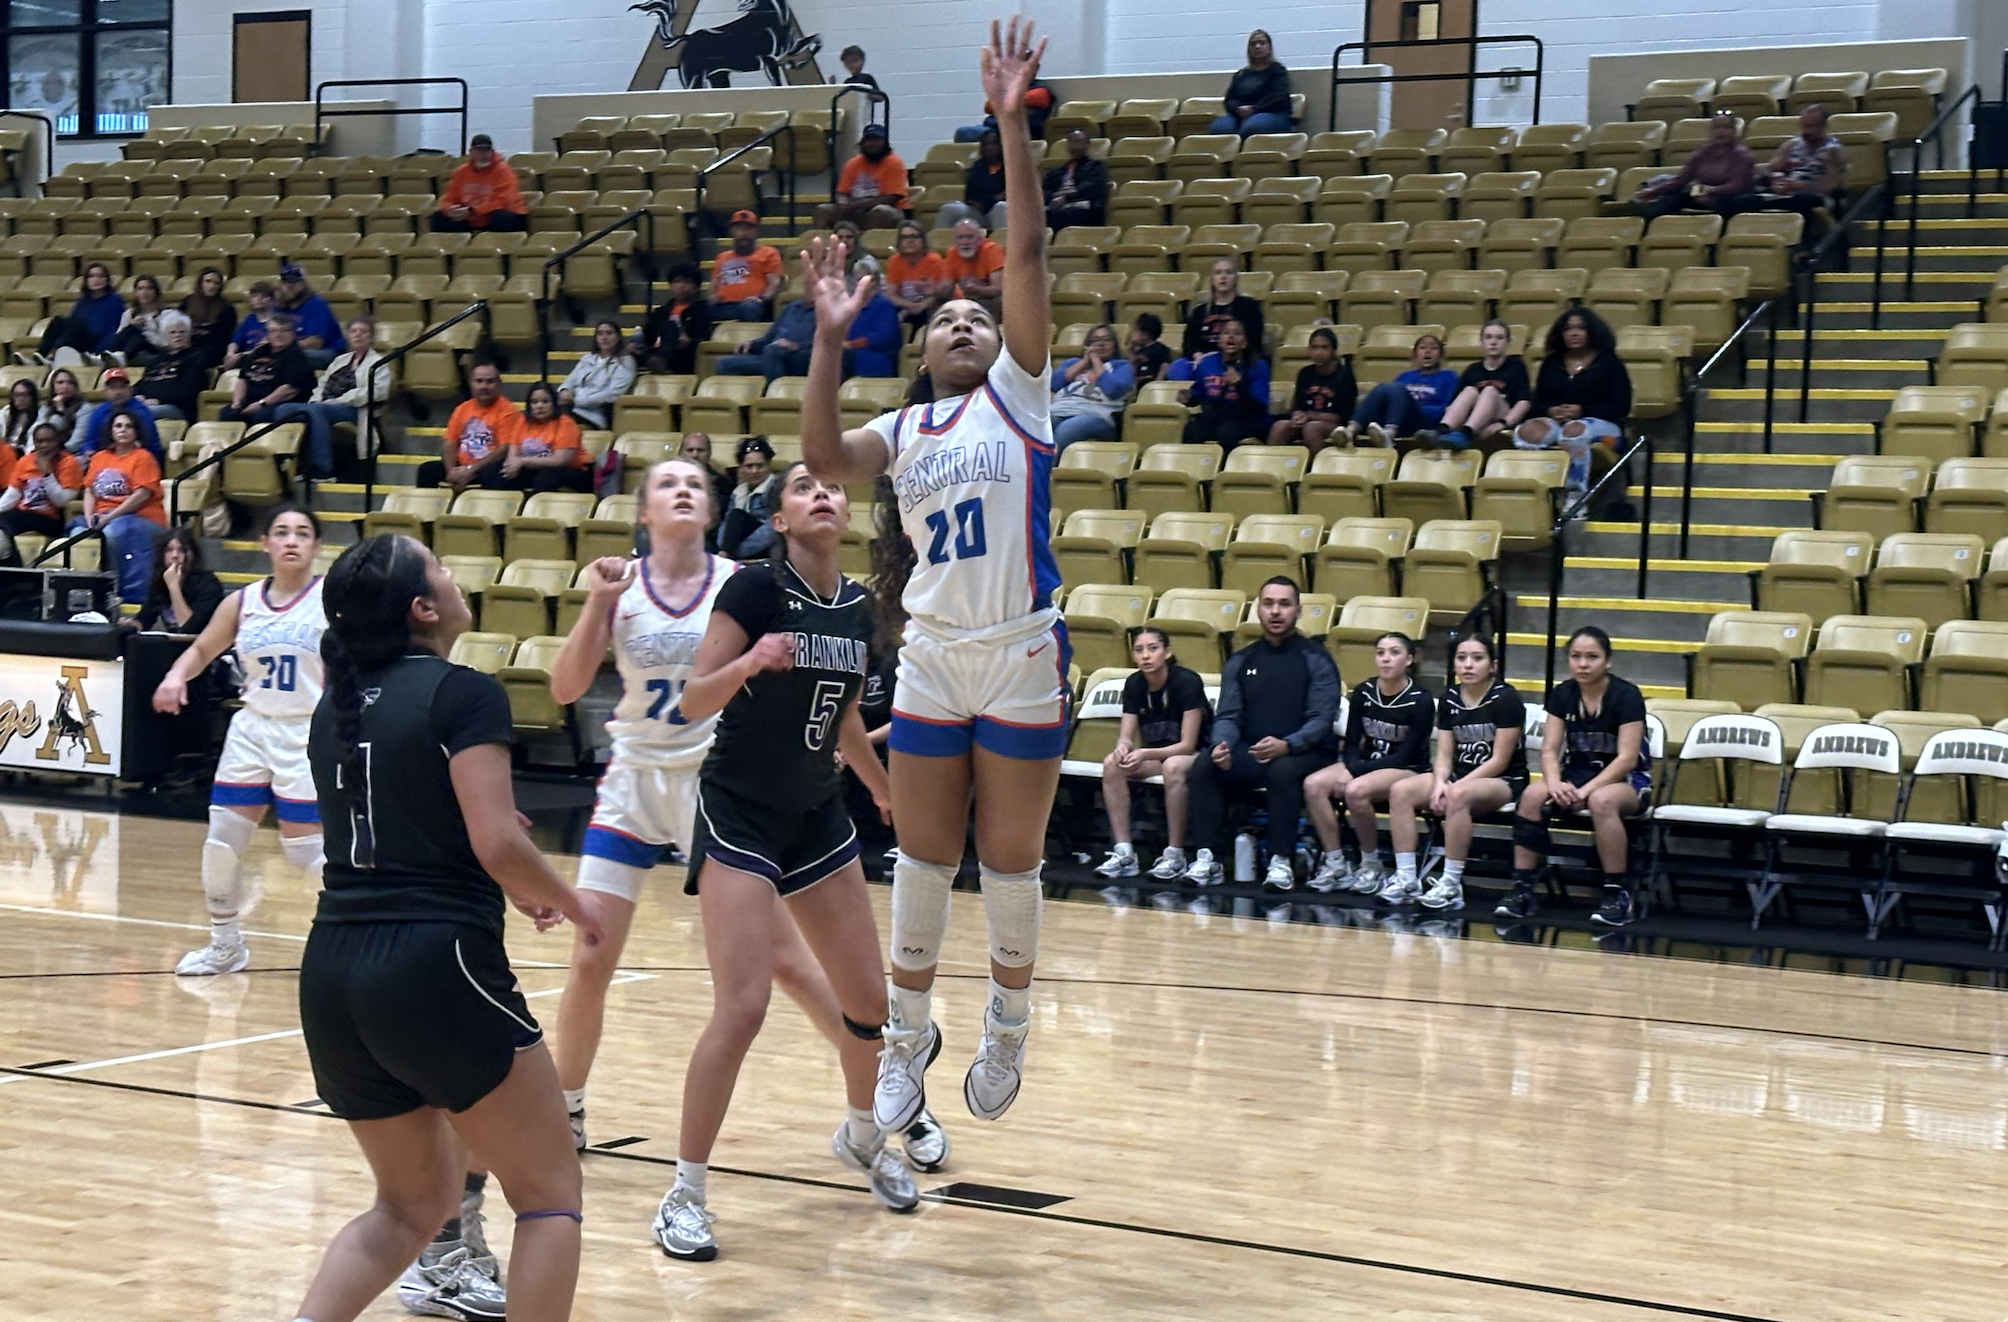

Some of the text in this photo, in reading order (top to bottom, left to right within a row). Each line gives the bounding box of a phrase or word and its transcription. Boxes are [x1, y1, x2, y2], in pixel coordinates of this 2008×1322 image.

[894, 441, 1011, 514] CENTRAL
[925, 497, 987, 567] 20
[36, 665, 111, 765] A
[805, 680, 846, 751] 5
[1696, 727, 1771, 747] ANDREWS
[1812, 736, 1889, 757] ANDREWS
